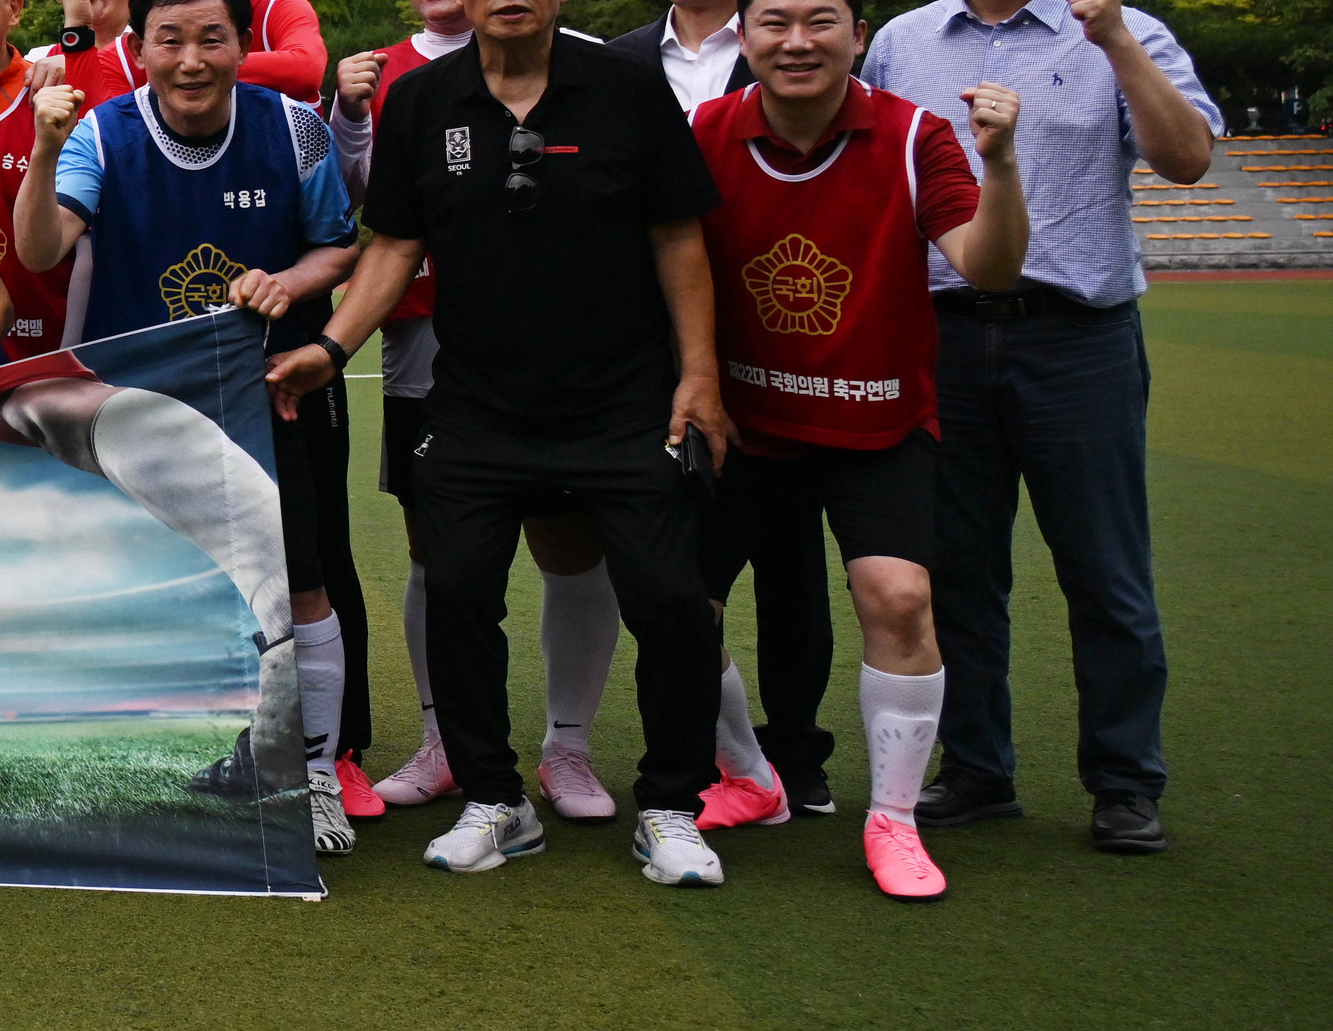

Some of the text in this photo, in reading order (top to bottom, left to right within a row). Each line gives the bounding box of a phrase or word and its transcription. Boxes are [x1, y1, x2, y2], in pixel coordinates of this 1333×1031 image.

[448, 163, 472, 172] SEOUL
[223, 188, 267, 209] 박용갑
[185, 282, 227, 307] 국회
[773, 276, 818, 302] 국회
[727, 360, 900, 401] 제22대 국회의원 축구연맹
